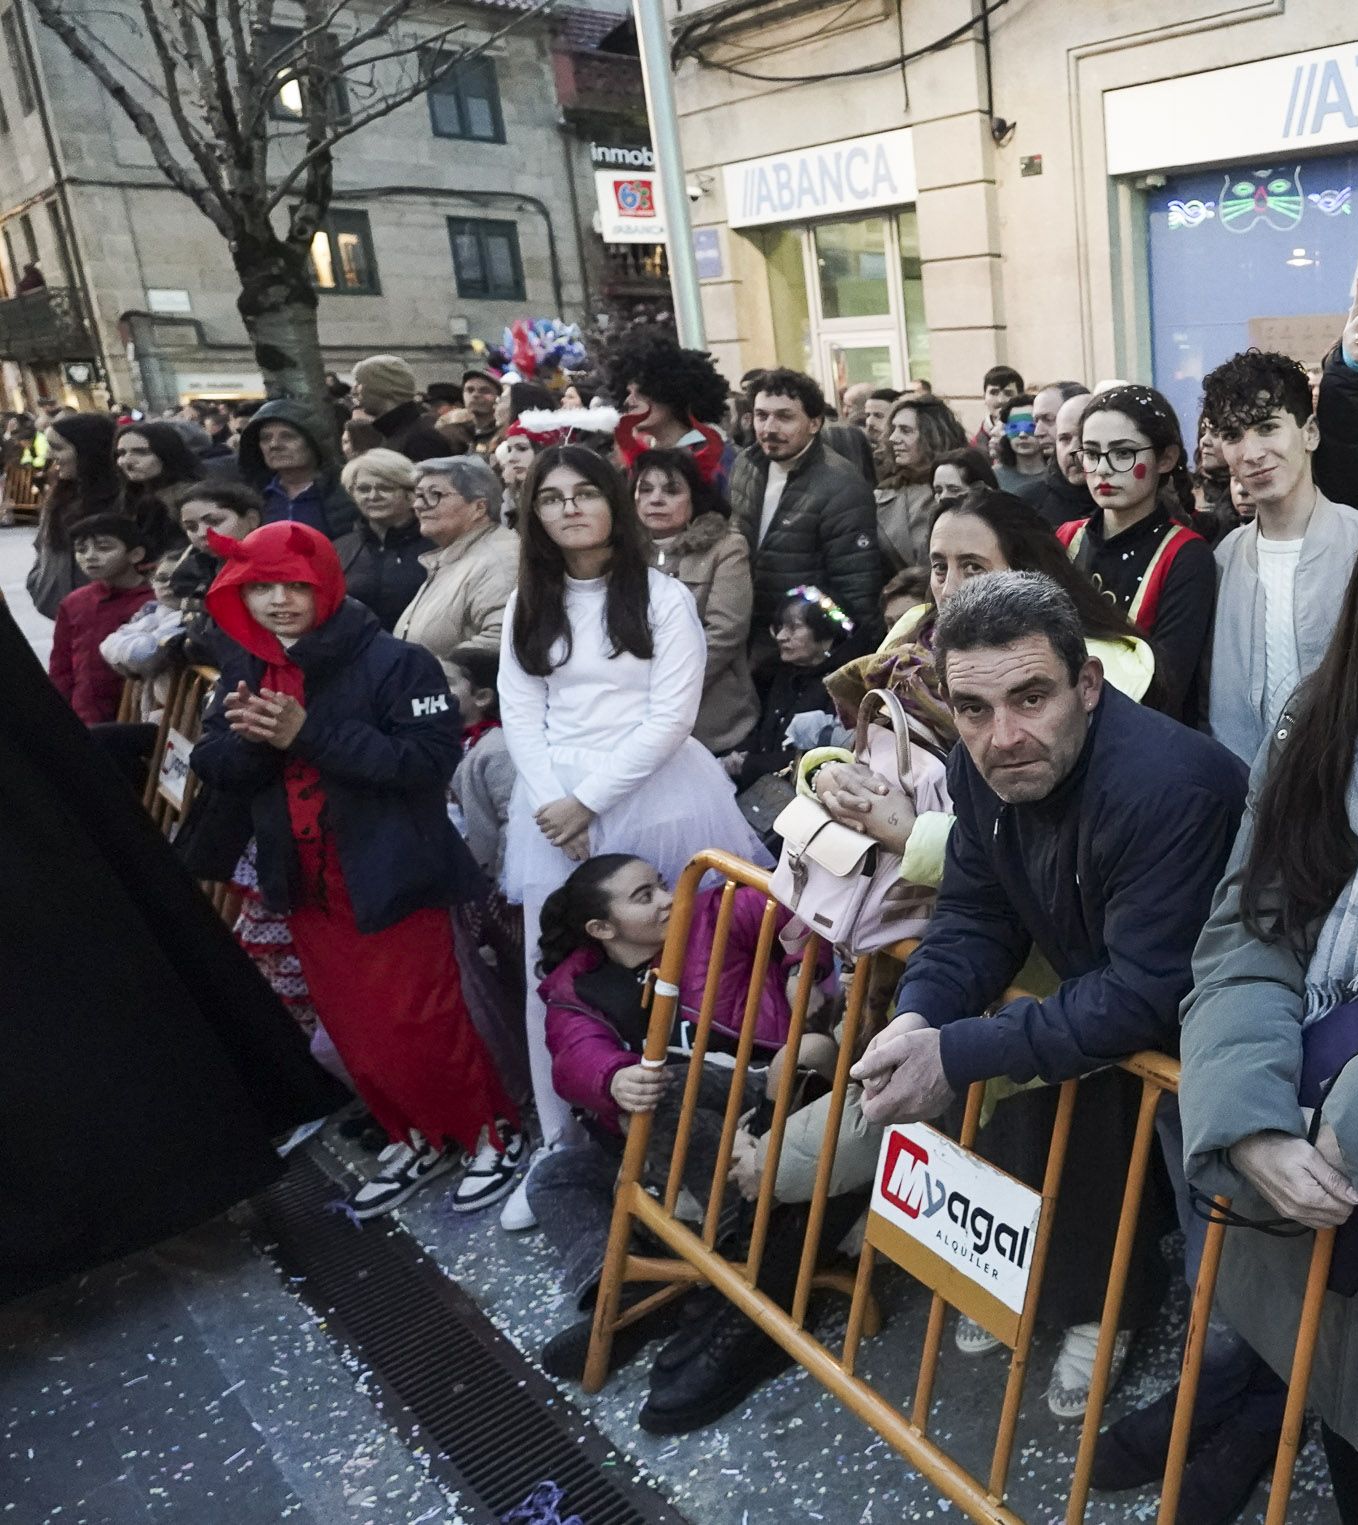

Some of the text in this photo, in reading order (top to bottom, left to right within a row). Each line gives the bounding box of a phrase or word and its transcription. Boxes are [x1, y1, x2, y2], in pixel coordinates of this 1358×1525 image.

[756, 144, 899, 217] ABANCA
[411, 694, 449, 717] HH
[886, 1148, 1030, 1269] Myagal
[936, 1229, 999, 1280] ALQUILER
